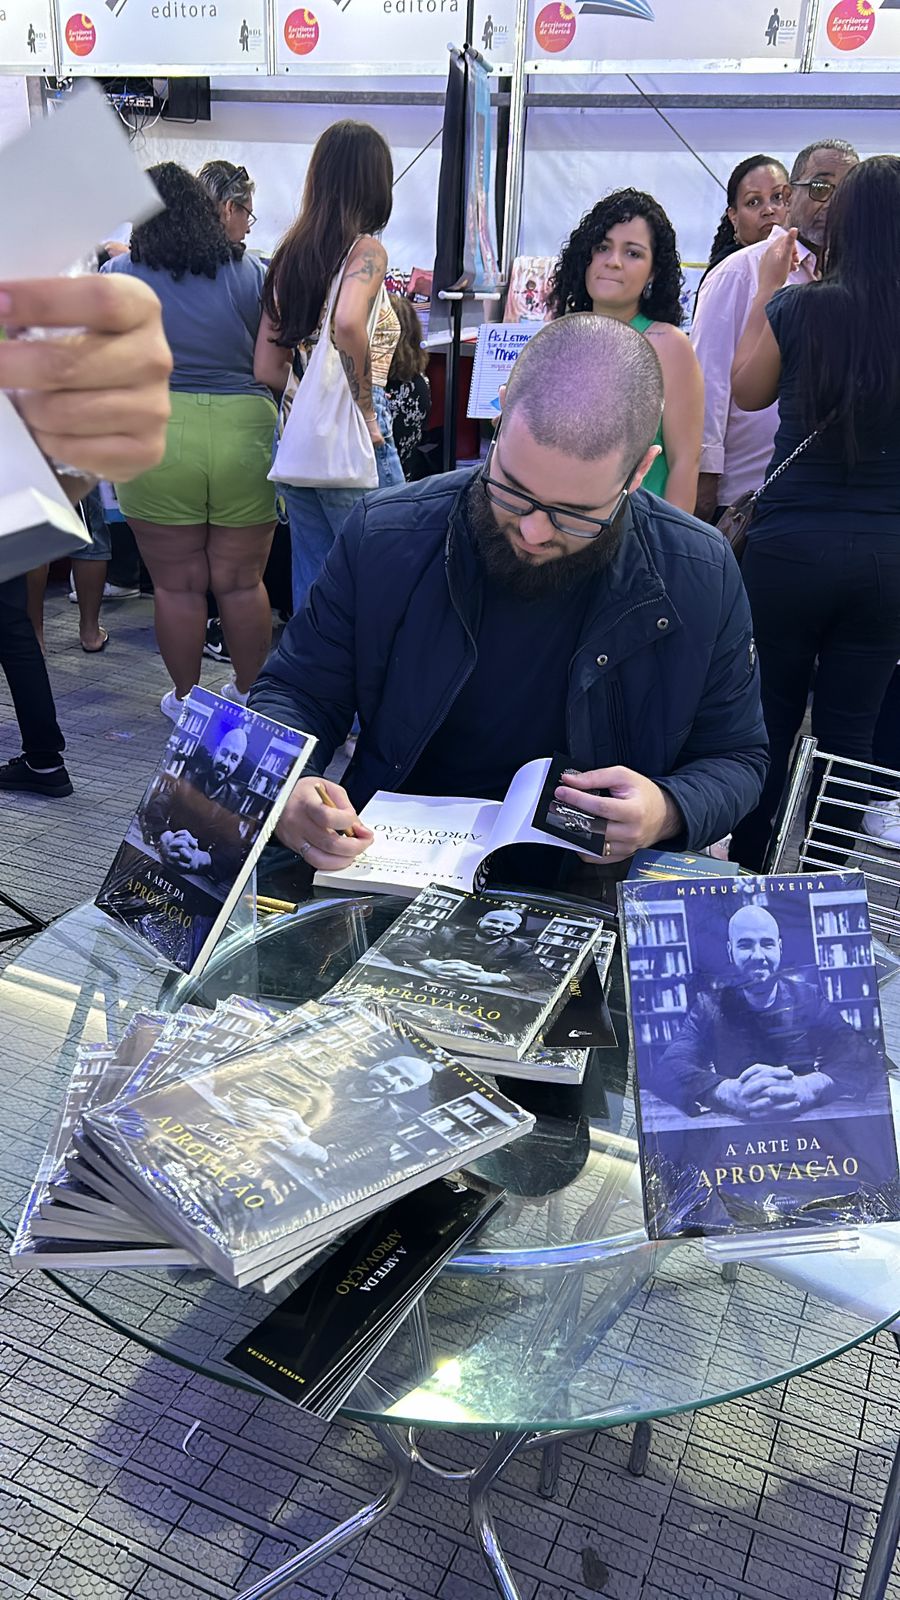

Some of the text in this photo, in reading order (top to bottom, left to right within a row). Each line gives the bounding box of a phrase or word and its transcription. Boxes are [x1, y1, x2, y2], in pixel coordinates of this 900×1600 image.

[151, 1, 217, 18] editora
[538, 21, 572, 29] Escritores
[831, 24, 842, 32] de
[832, 16, 870, 25] Escritores
[843, 23, 868, 31] Maricá
[373, 823, 482, 841] APROVAÇÃO
[385, 833, 406, 843] DA
[354, 863, 406, 874] TEIXEIR
[145, 870, 185, 902] A ARTE DA
[676, 880, 825, 896] MATEUS TEIXEIRA
[419, 984, 456, 998] ARTE
[459, 993, 479, 1003] DA
[374, 985, 501, 1021] APROVAÇÃO
[725, 1137, 821, 1156] A ARTE DA
[152, 1116, 265, 1209] APROVAÇÃO
[696, 1155, 859, 1188] APROVAÇÃO
[335, 1228, 402, 1295] APROVAÇÃO
[359, 1245, 407, 1292] A ARTE DA
[247, 1347, 306, 1384] MATEUS TEIXEIRA
